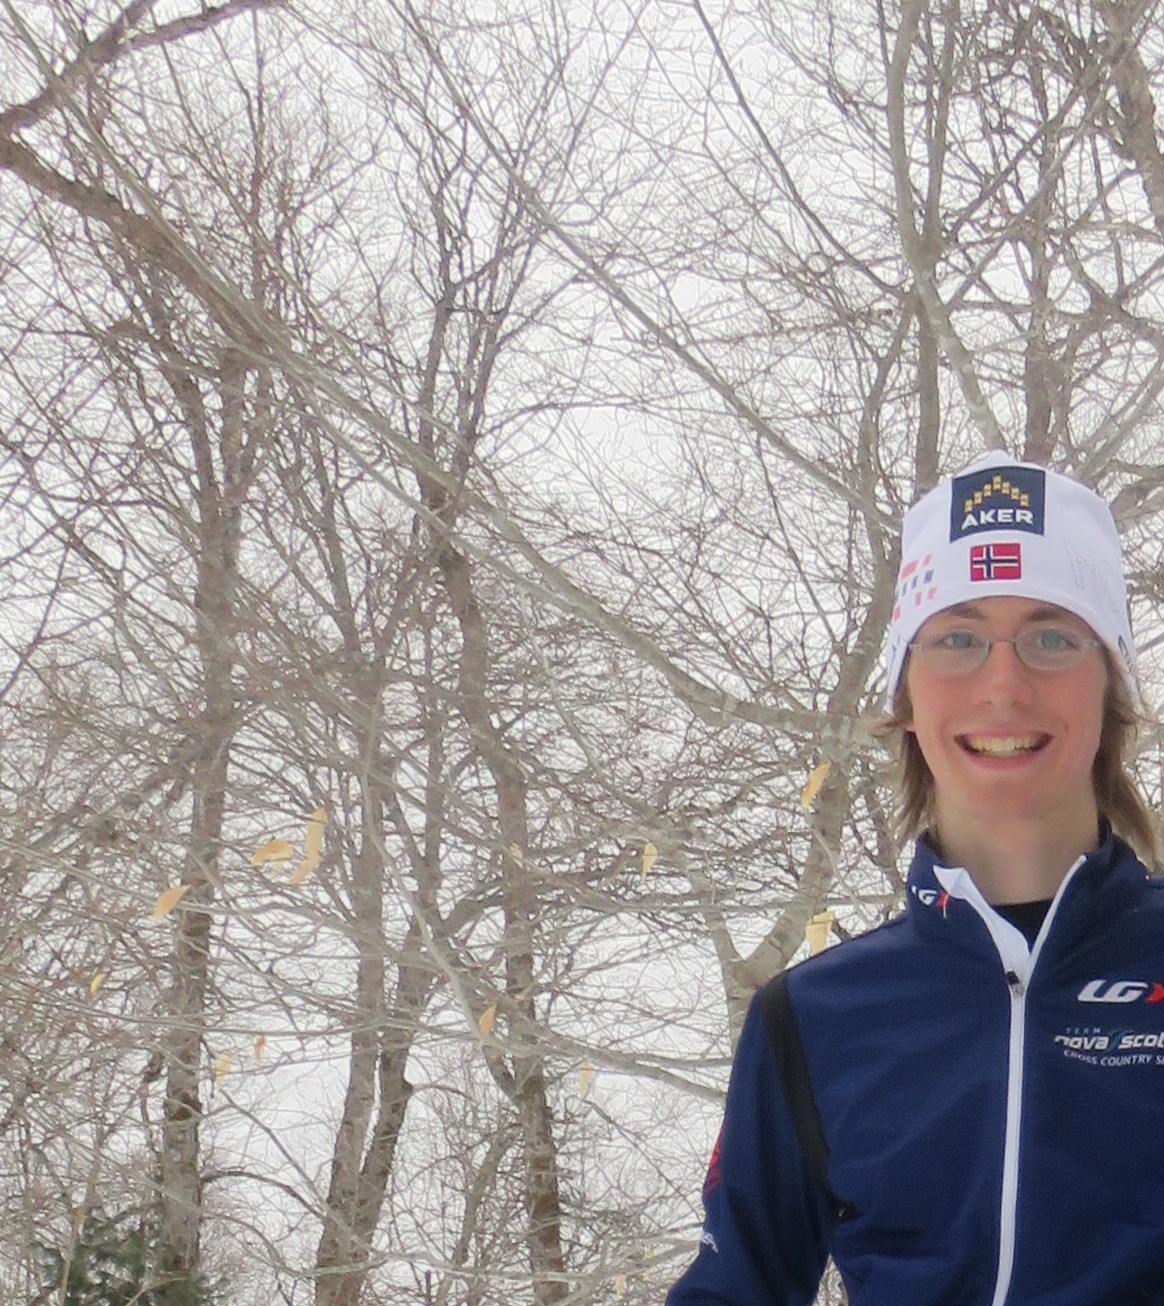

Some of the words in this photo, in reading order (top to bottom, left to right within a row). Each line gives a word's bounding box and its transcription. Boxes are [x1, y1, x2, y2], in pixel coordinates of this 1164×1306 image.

[960, 507, 1034, 531] AKER
[1077, 979, 1149, 1004] LG
[1065, 1026, 1102, 1035] TEAM
[1054, 1034, 1110, 1051] nova
[1063, 1050, 1098, 1066] CROSS
[1100, 1053, 1154, 1068] COUNTRY
